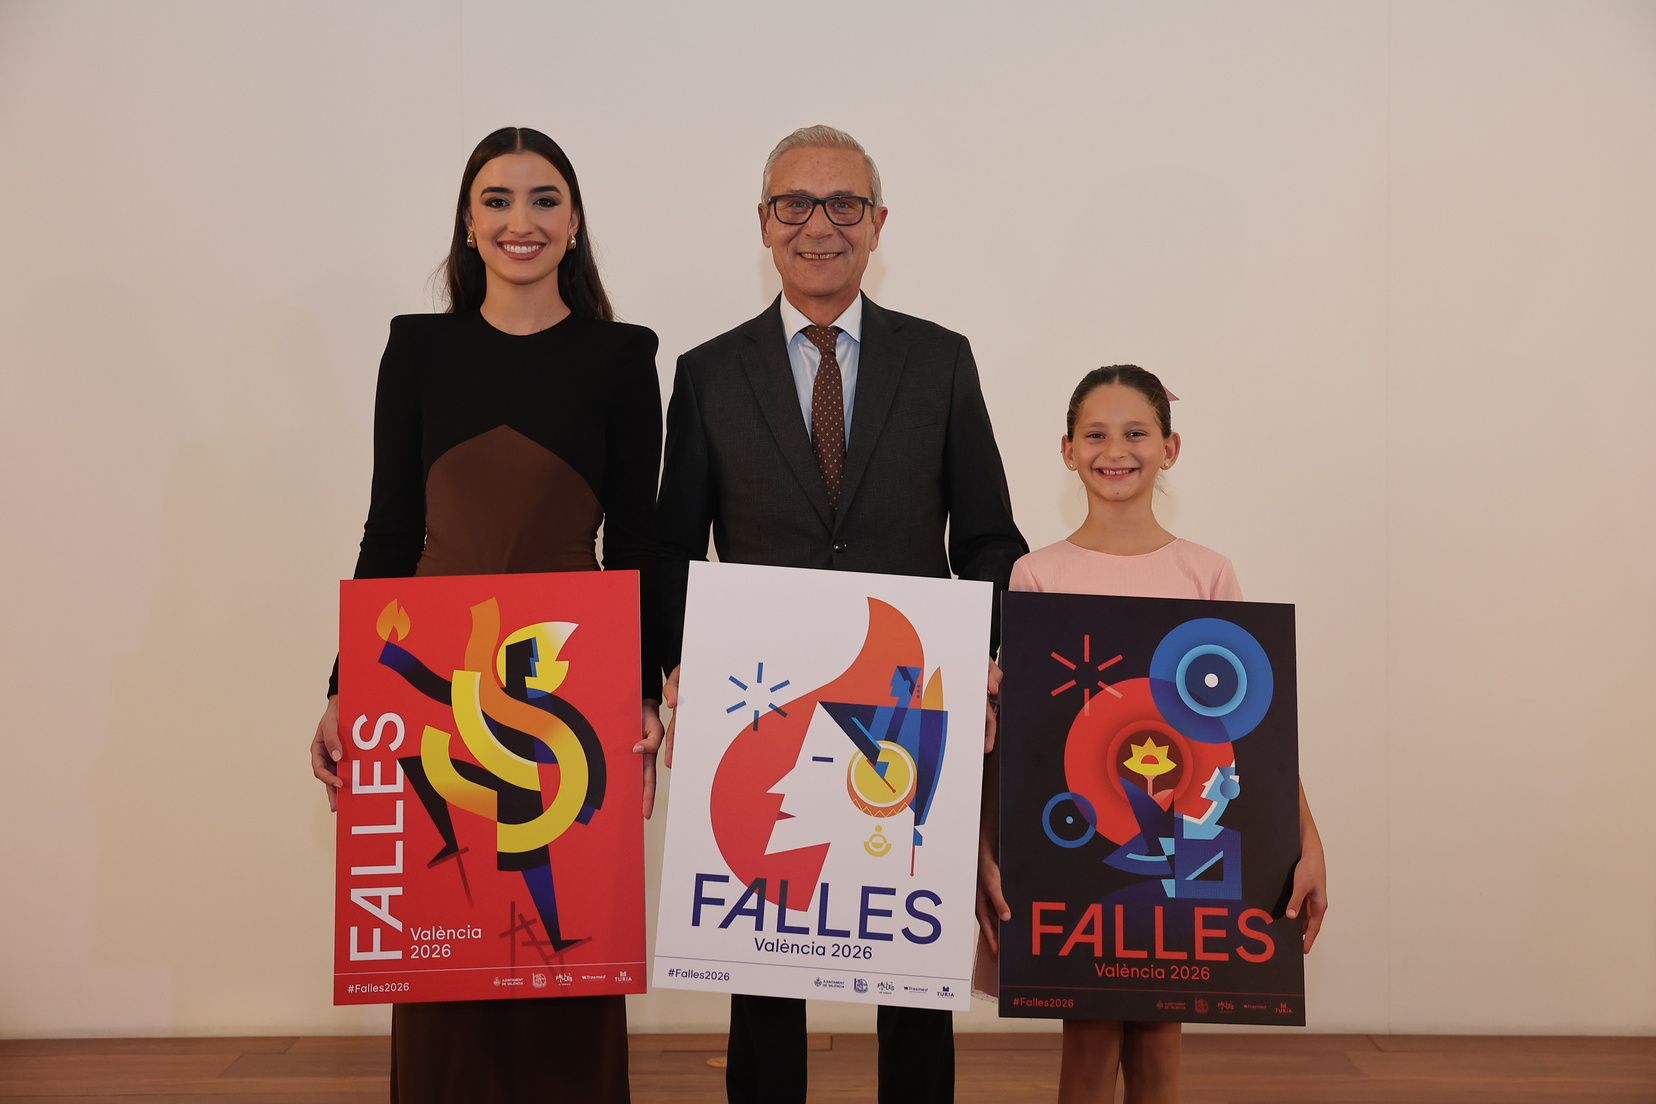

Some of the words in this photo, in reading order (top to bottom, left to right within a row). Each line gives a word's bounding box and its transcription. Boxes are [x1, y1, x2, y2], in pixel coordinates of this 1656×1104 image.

[349, 712, 406, 961] FALLES
[691, 872, 943, 945] FALLES
[410, 924, 482, 941] València
[1031, 901, 1276, 963] FALLES
[410, 943, 451, 959] 2026
[754, 937, 826, 956] València
[831, 943, 873, 960] 2026
[668, 968, 730, 981] #Falles2026
[1094, 962, 1165, 979] València
[1170, 965, 1211, 981] 2026
[347, 982, 410, 994] #Falles2026
[1013, 997, 1075, 1008] #Falles2026
